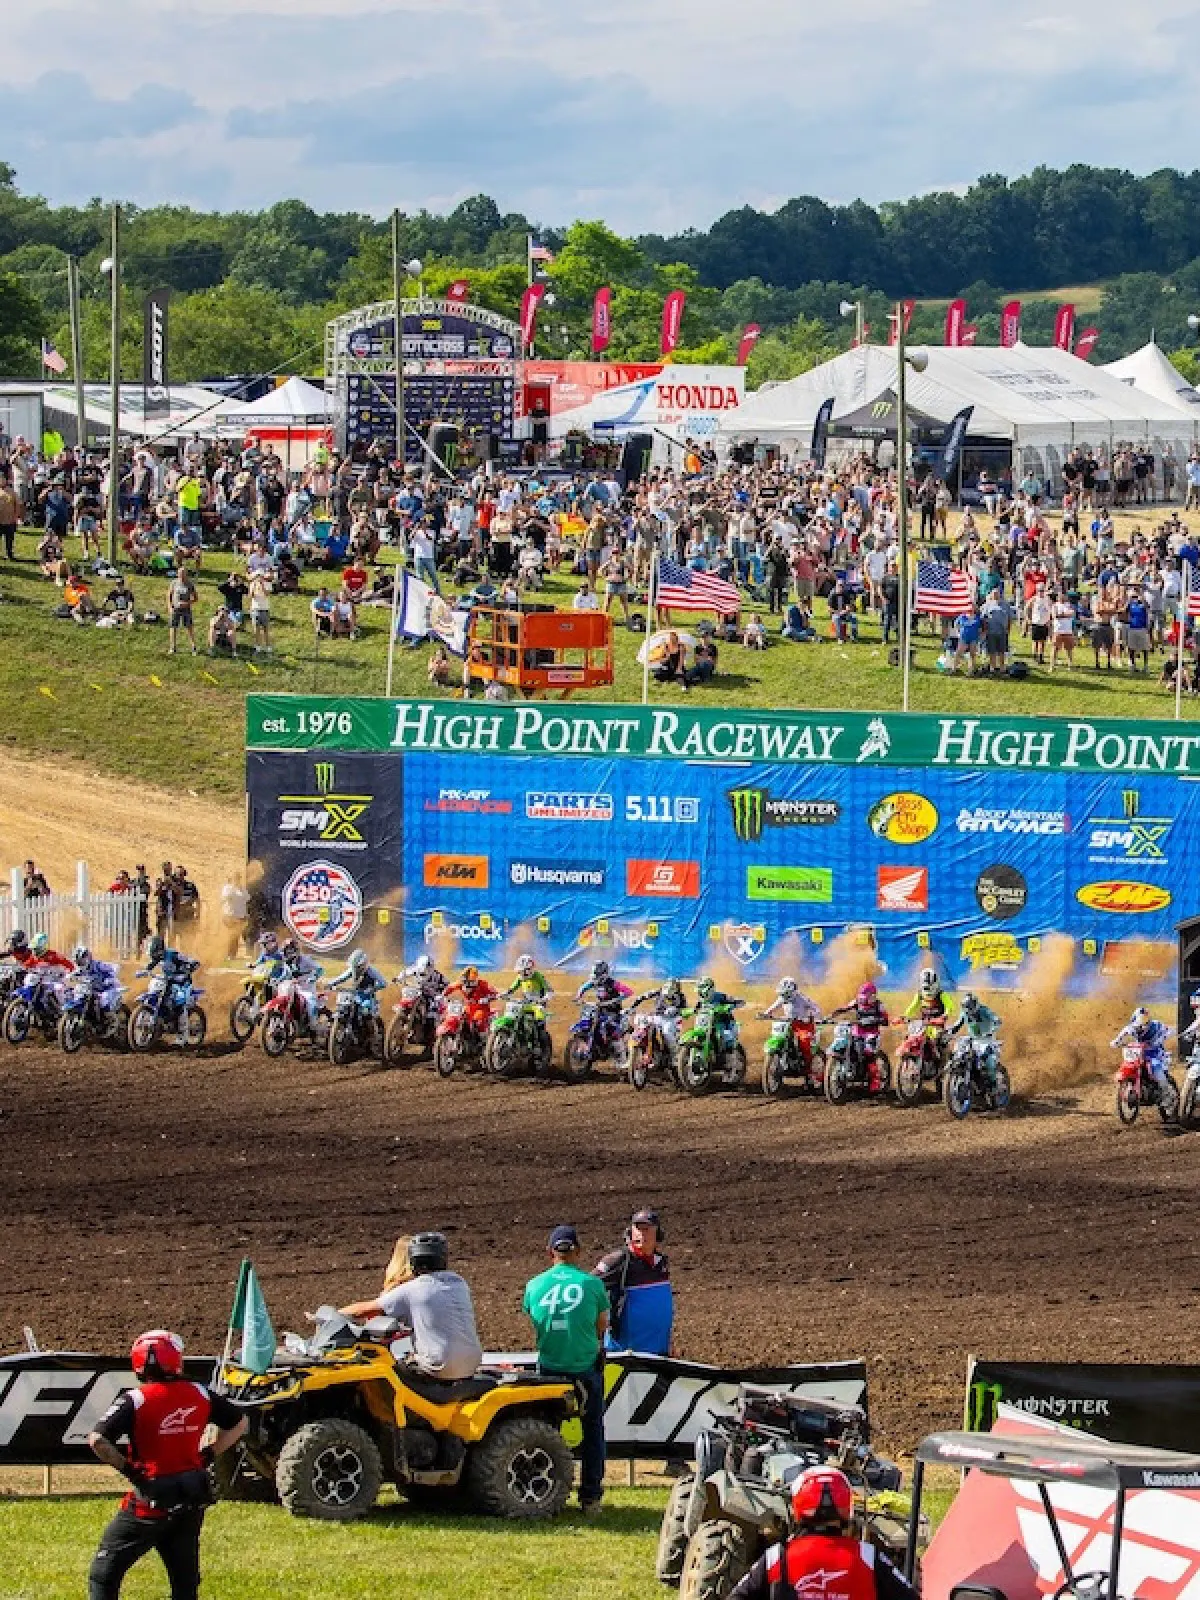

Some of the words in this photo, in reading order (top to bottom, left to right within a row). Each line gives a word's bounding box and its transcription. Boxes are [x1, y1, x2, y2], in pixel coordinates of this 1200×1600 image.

[657, 385, 739, 409] HONDA
[262, 717, 291, 732] est.
[297, 711, 352, 735] 1976
[390, 704, 504, 749] HIGH
[508, 707, 640, 753] POINT
[645, 711, 845, 759] RACEWAY
[933, 719, 1054, 766] HIGH
[1060, 723, 1199, 771] POINT
[527, 794, 610, 809] PARTS
[626, 796, 673, 822] 5.11
[765, 800, 837, 817] MONSTER
[277, 803, 371, 841] SMX
[527, 808, 611, 819] UNLIMITED
[1088, 825, 1168, 857] SMX
[436, 863, 477, 879] KTM
[527, 865, 603, 886] Husqvarna
[296, 885, 331, 901] 250
[757, 877, 824, 892] Kawasaki
[880, 899, 925, 909] HONDA
[539, 1283, 583, 1315] 49
